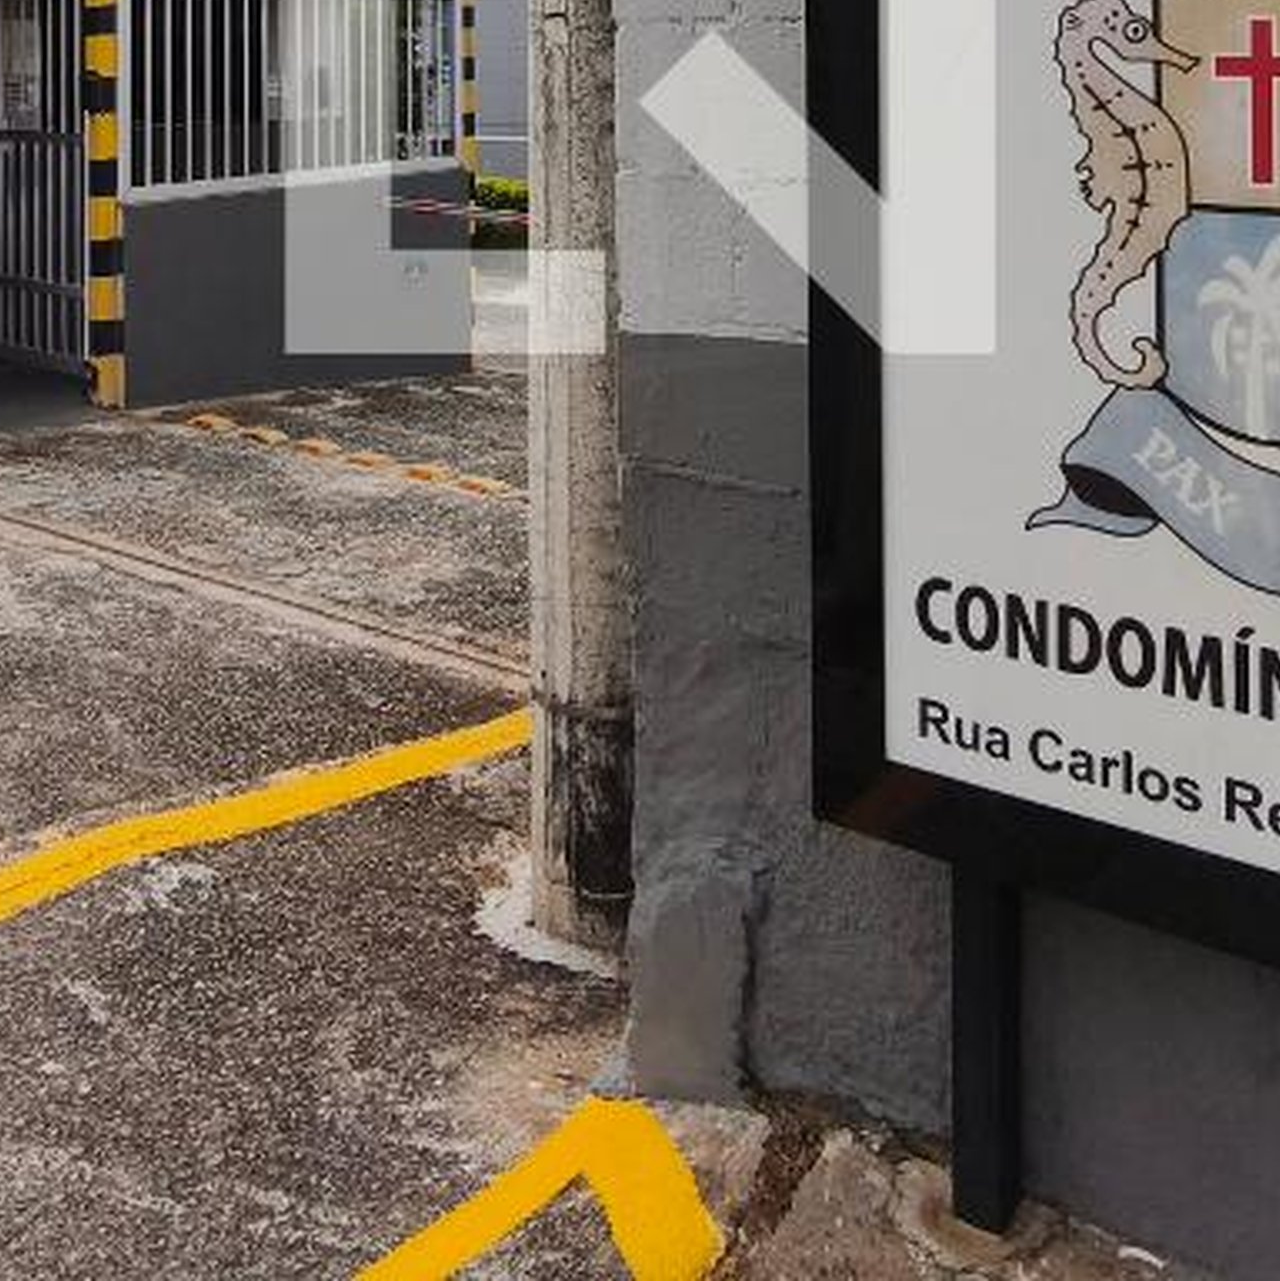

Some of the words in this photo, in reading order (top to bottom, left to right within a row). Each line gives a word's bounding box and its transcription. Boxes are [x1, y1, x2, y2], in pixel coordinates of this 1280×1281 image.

[1132, 426, 1236, 534] PAX
[918, 697, 1011, 762] Rua
[1028, 728, 1203, 813] Carlos
